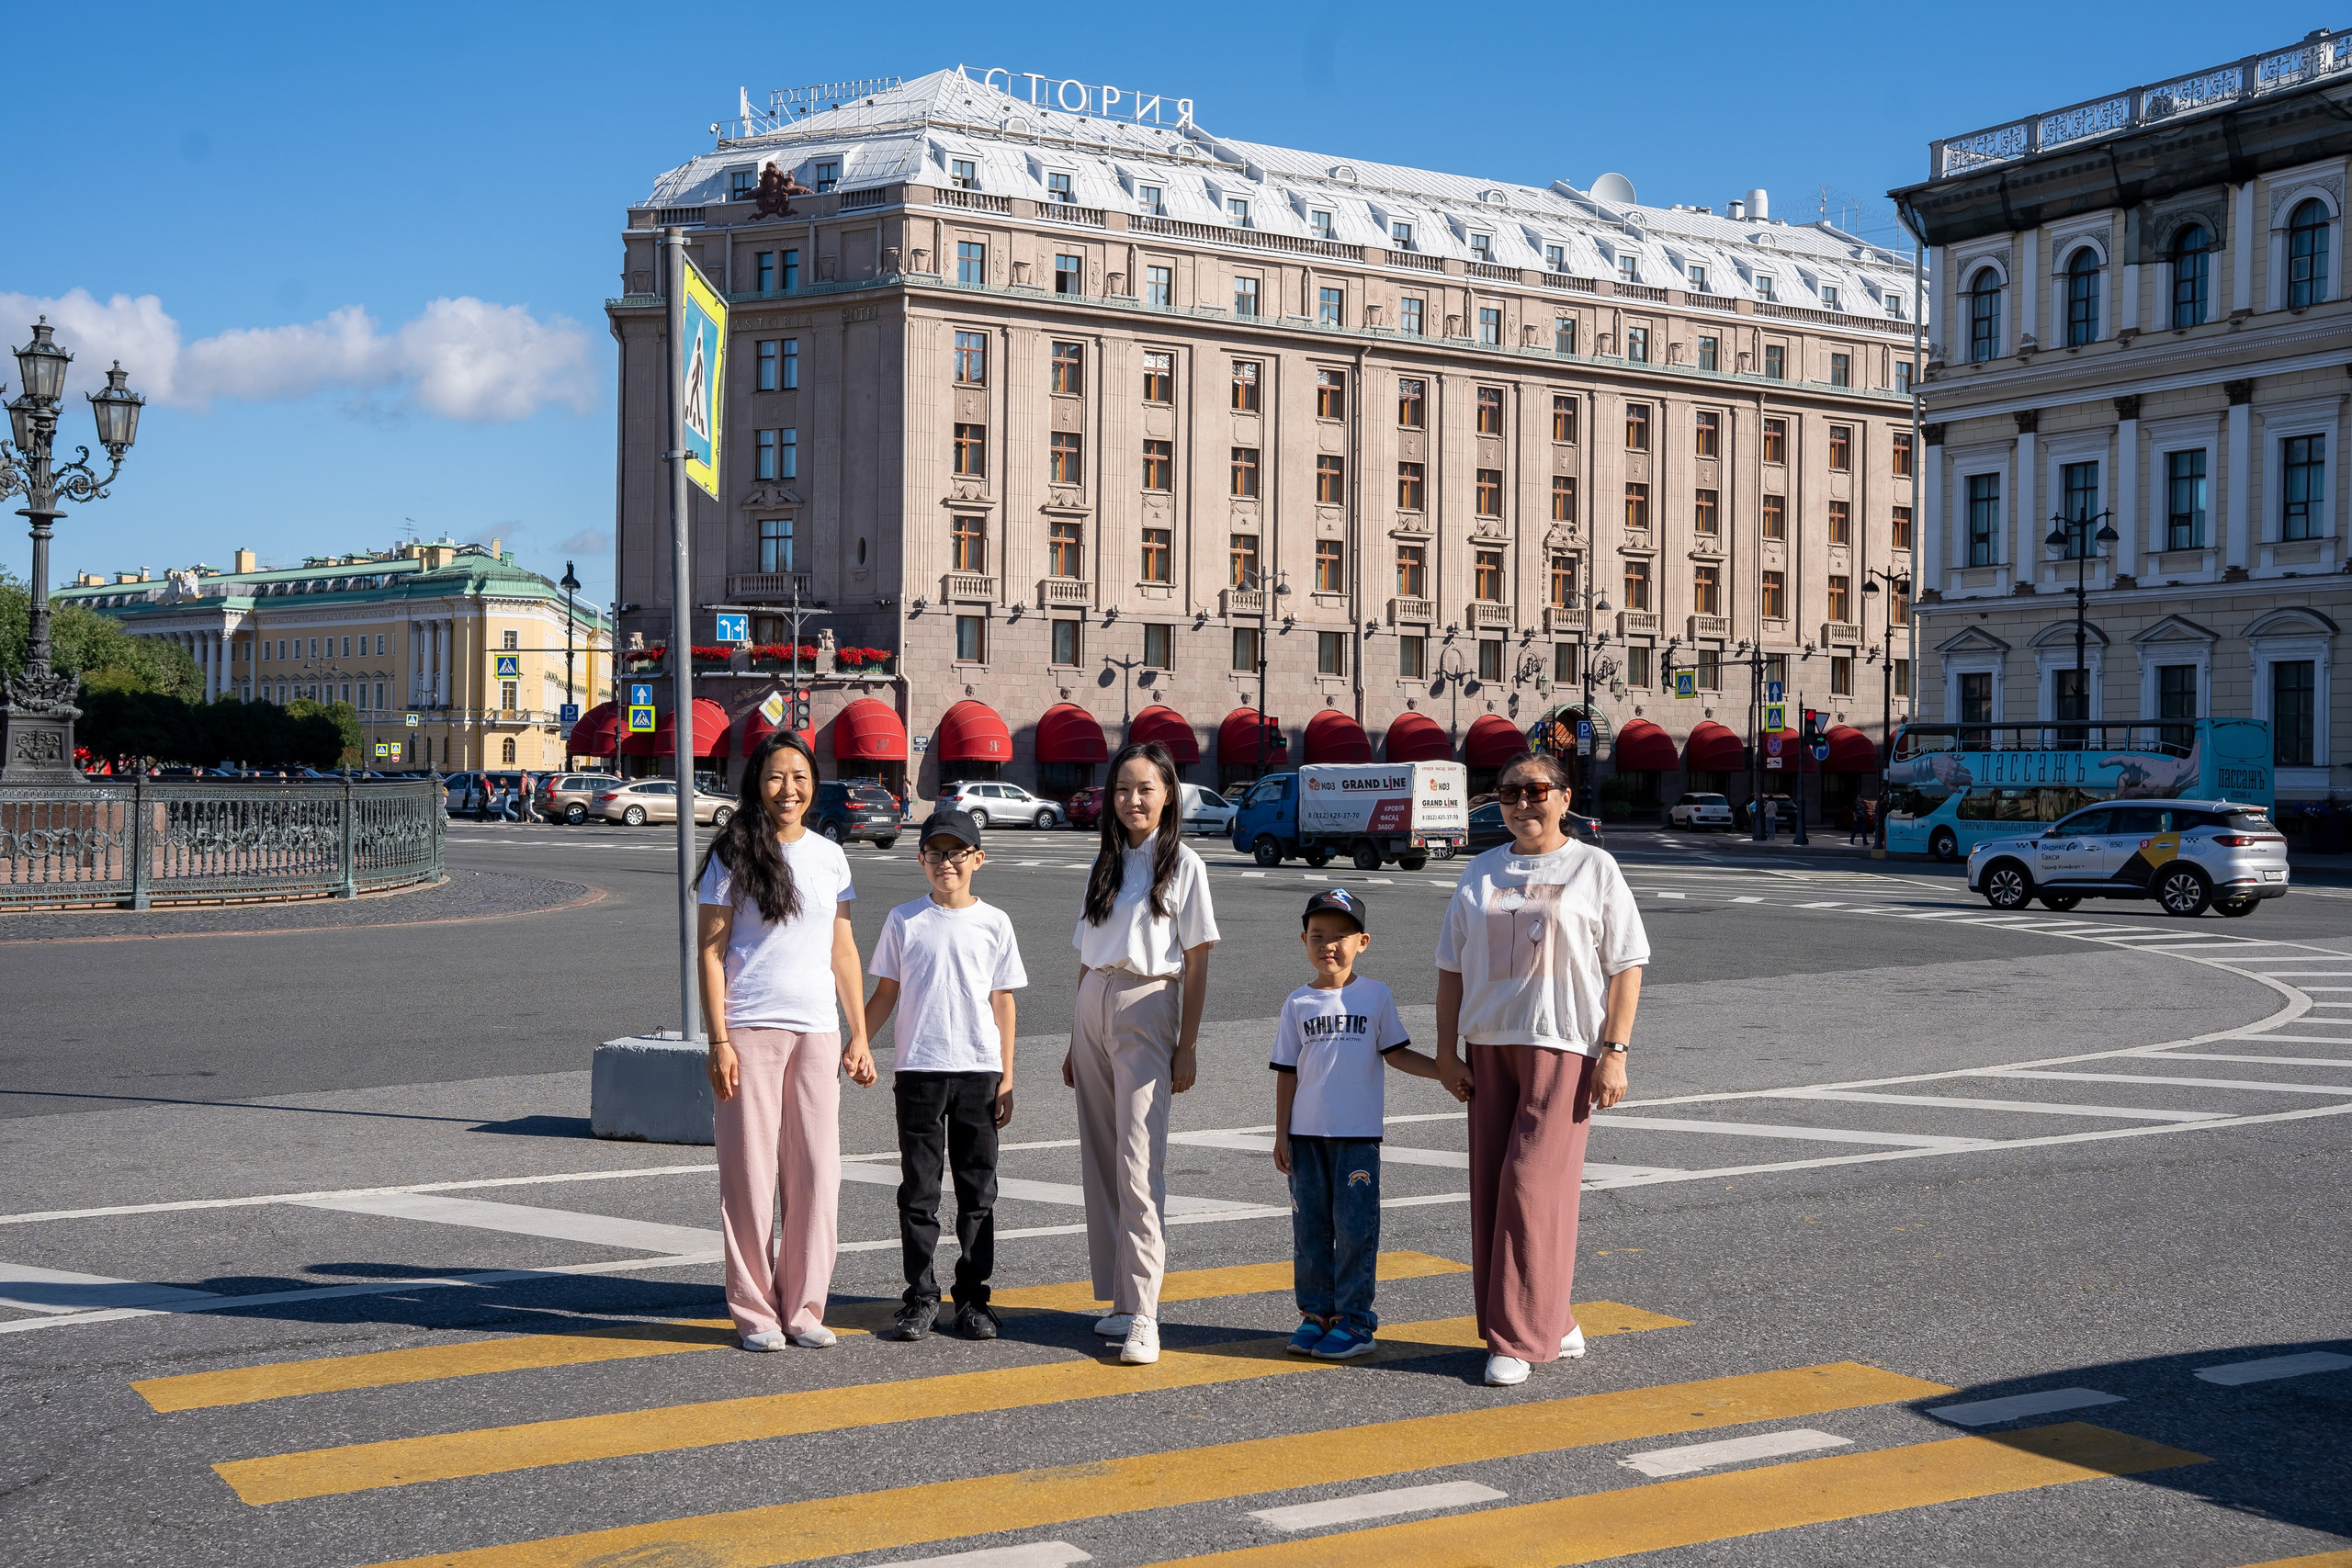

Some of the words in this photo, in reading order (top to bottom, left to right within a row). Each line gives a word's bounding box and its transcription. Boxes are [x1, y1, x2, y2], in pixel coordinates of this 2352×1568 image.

[770, 75, 906, 107] ГОСТИНИЦА
[947, 62, 1193, 130] АСТОРИЯ
[733, 314, 813, 331] ASTORIA
[842, 306, 879, 322] HOTEL
[1321, 782, 1336, 790] КФЗ
[1341, 779, 1380, 789] GRAND
[2065, 841, 2078, 852] Go
[2109, 840, 2123, 849] 650
[1303, 1014, 1368, 1037] ATHLETIC
